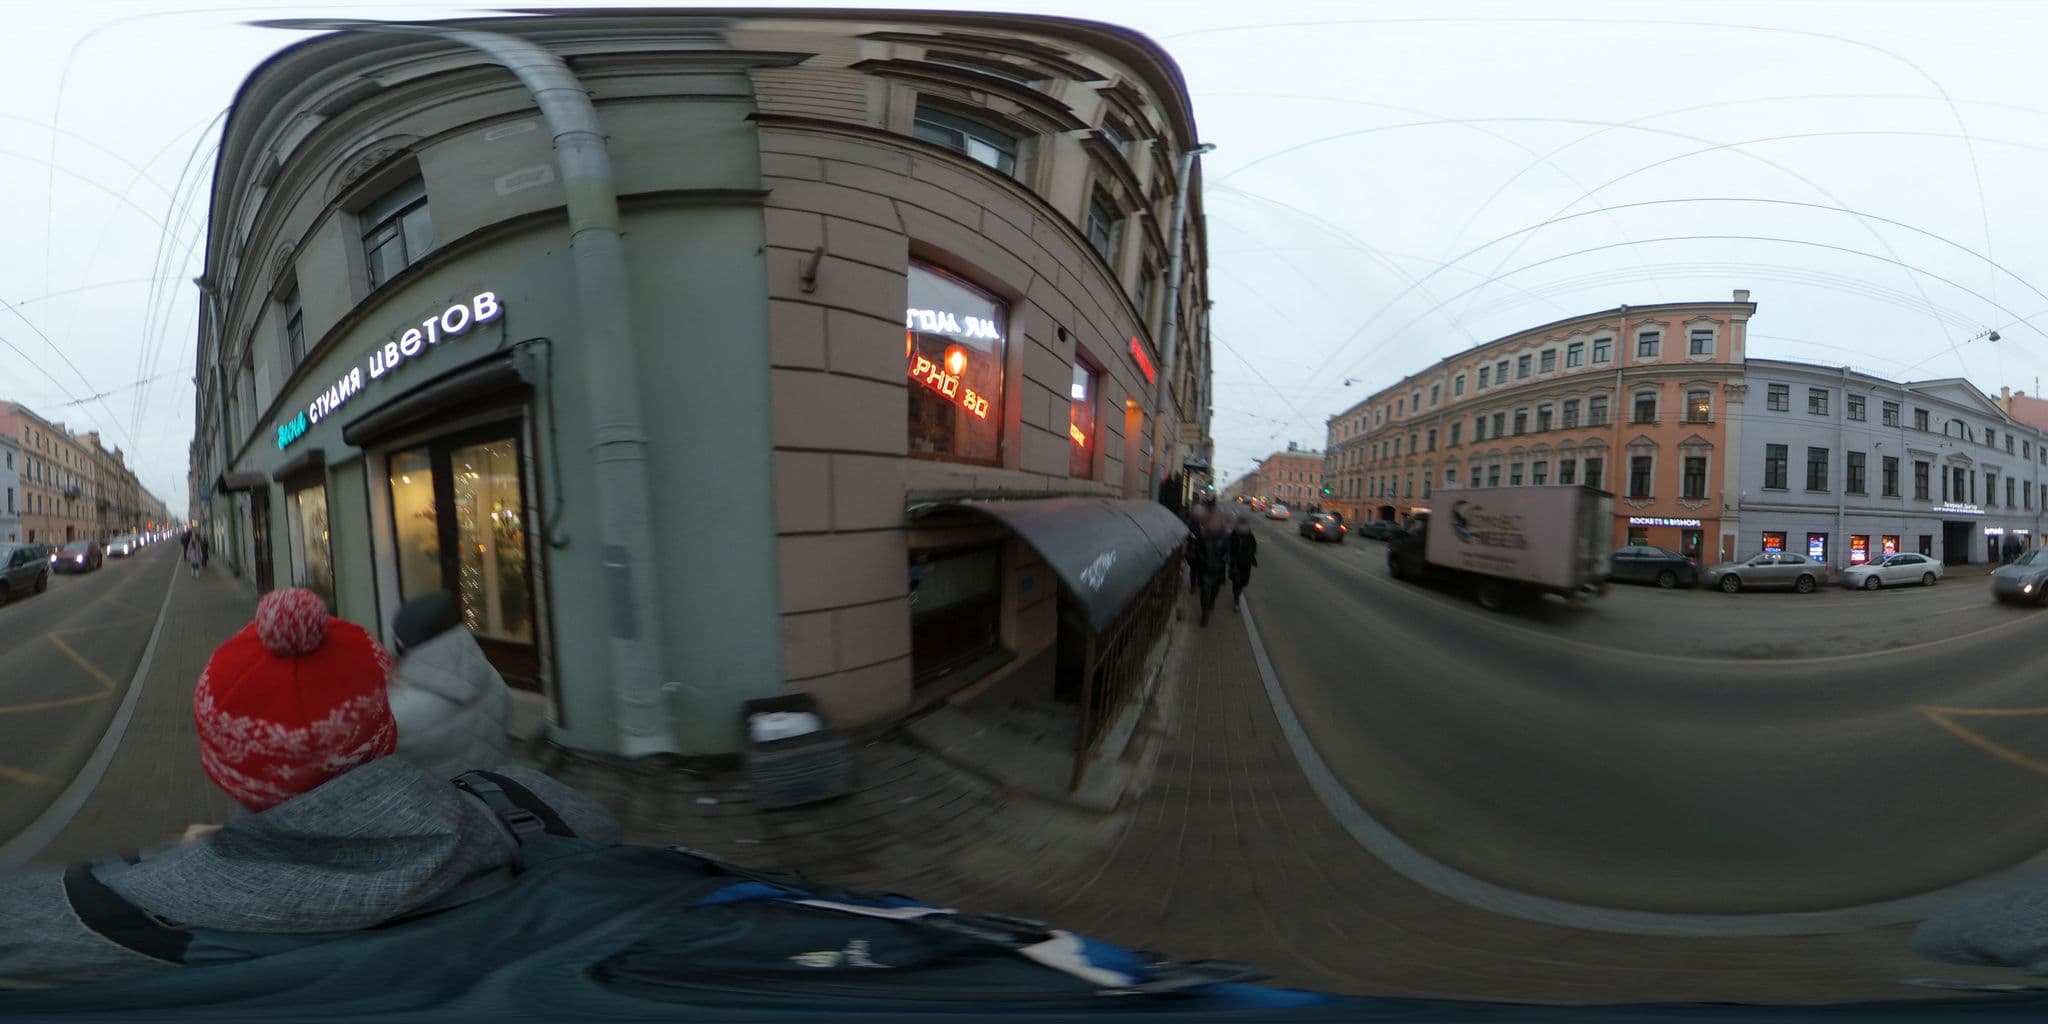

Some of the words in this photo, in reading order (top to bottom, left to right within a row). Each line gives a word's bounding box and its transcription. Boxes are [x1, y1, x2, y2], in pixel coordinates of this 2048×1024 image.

[964, 315, 1001, 340] ЯМ
[309, 366, 362, 425] СТУДИЯ
[369, 291, 500, 380] ЦВЕТОВ
[912, 356, 960, 399] PHO
[963, 388, 989, 419] BO
[1629, 516, 1663, 526] ROCKETS
[1669, 518, 1702, 528] BISHOPS
